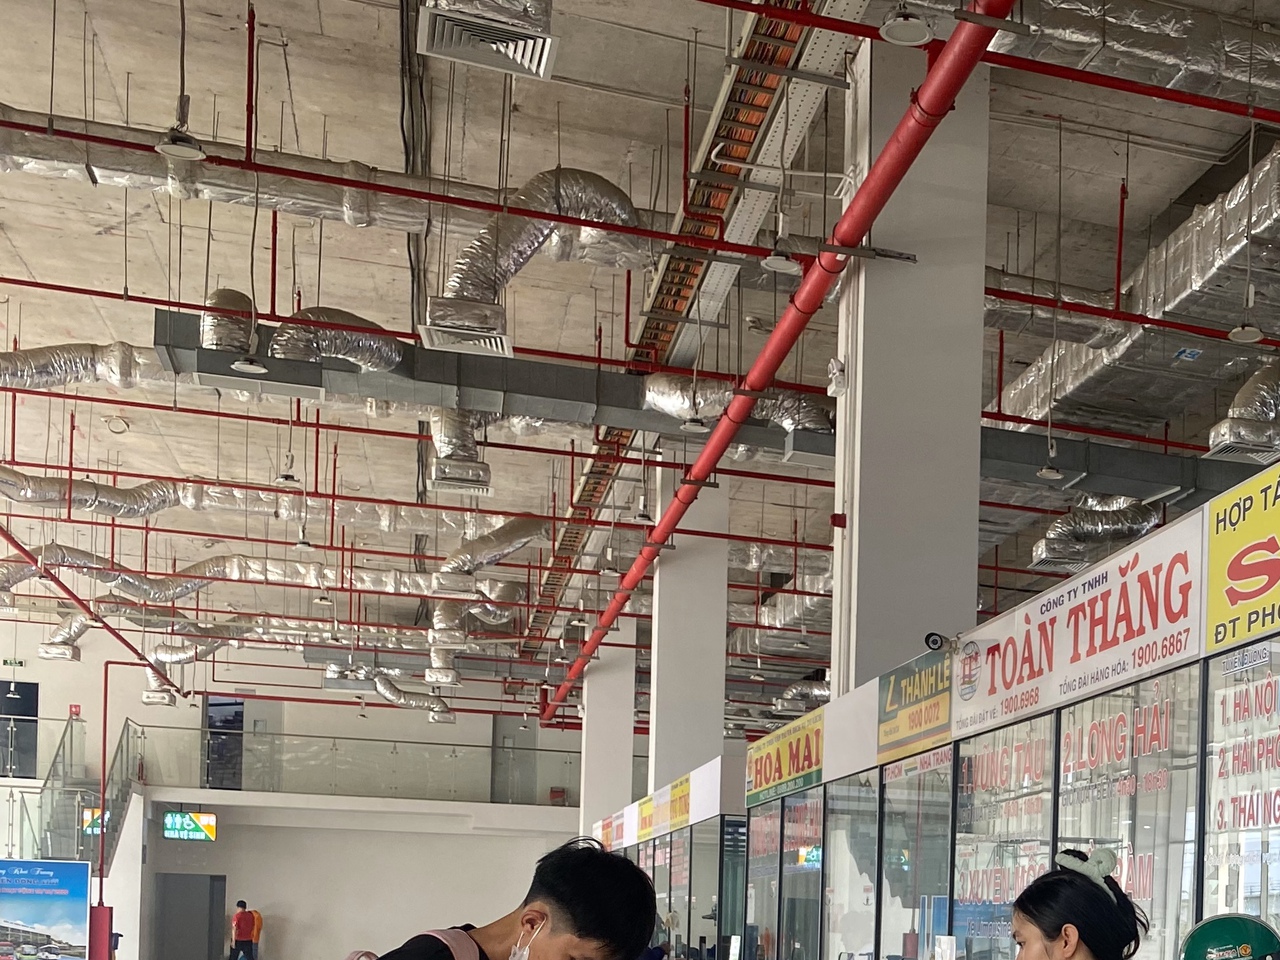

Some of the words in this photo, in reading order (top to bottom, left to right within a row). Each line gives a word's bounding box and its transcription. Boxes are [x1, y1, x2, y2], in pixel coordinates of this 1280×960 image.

[1215, 495, 1253, 535] HỢP
[1040, 594, 1065, 615] CÔNG
[1067, 586, 1079, 602] TY
[1082, 570, 1108, 594] TNHH
[985, 612, 1057, 697] TOÀN
[1066, 550, 1193, 664] THẮNG
[1214, 617, 1245, 645] ĐT
[1059, 676, 1077, 696] TỔNG
[1078, 670, 1089, 690] ĐÀI
[1090, 665, 1110, 686] HÀNG
[1111, 658, 1129, 677] HÓA:
[1131, 627, 1191, 669] 1900.6867
[901, 667, 935, 706] THÀNH
[1000, 686, 1040, 716] 1900.6968
[1233, 678, 1251, 723] HÀ
[1254, 670, 1278, 722] NỘI
[908, 708, 923, 731] 1900
[924, 701, 940, 725] 0072
[1133, 679, 1170, 759] HẢI
[754, 746, 783, 790] HOA
[788, 728, 821, 777] MAI
[919, 755, 932, 771] NHA
[932, 748, 952, 768] TRANG
[1218, 747, 1229, 779] 2.
[1231, 728, 1255, 776] HẢI
[1217, 798, 1227, 831] 3.
[1231, 785, 1261, 829] THÁI
